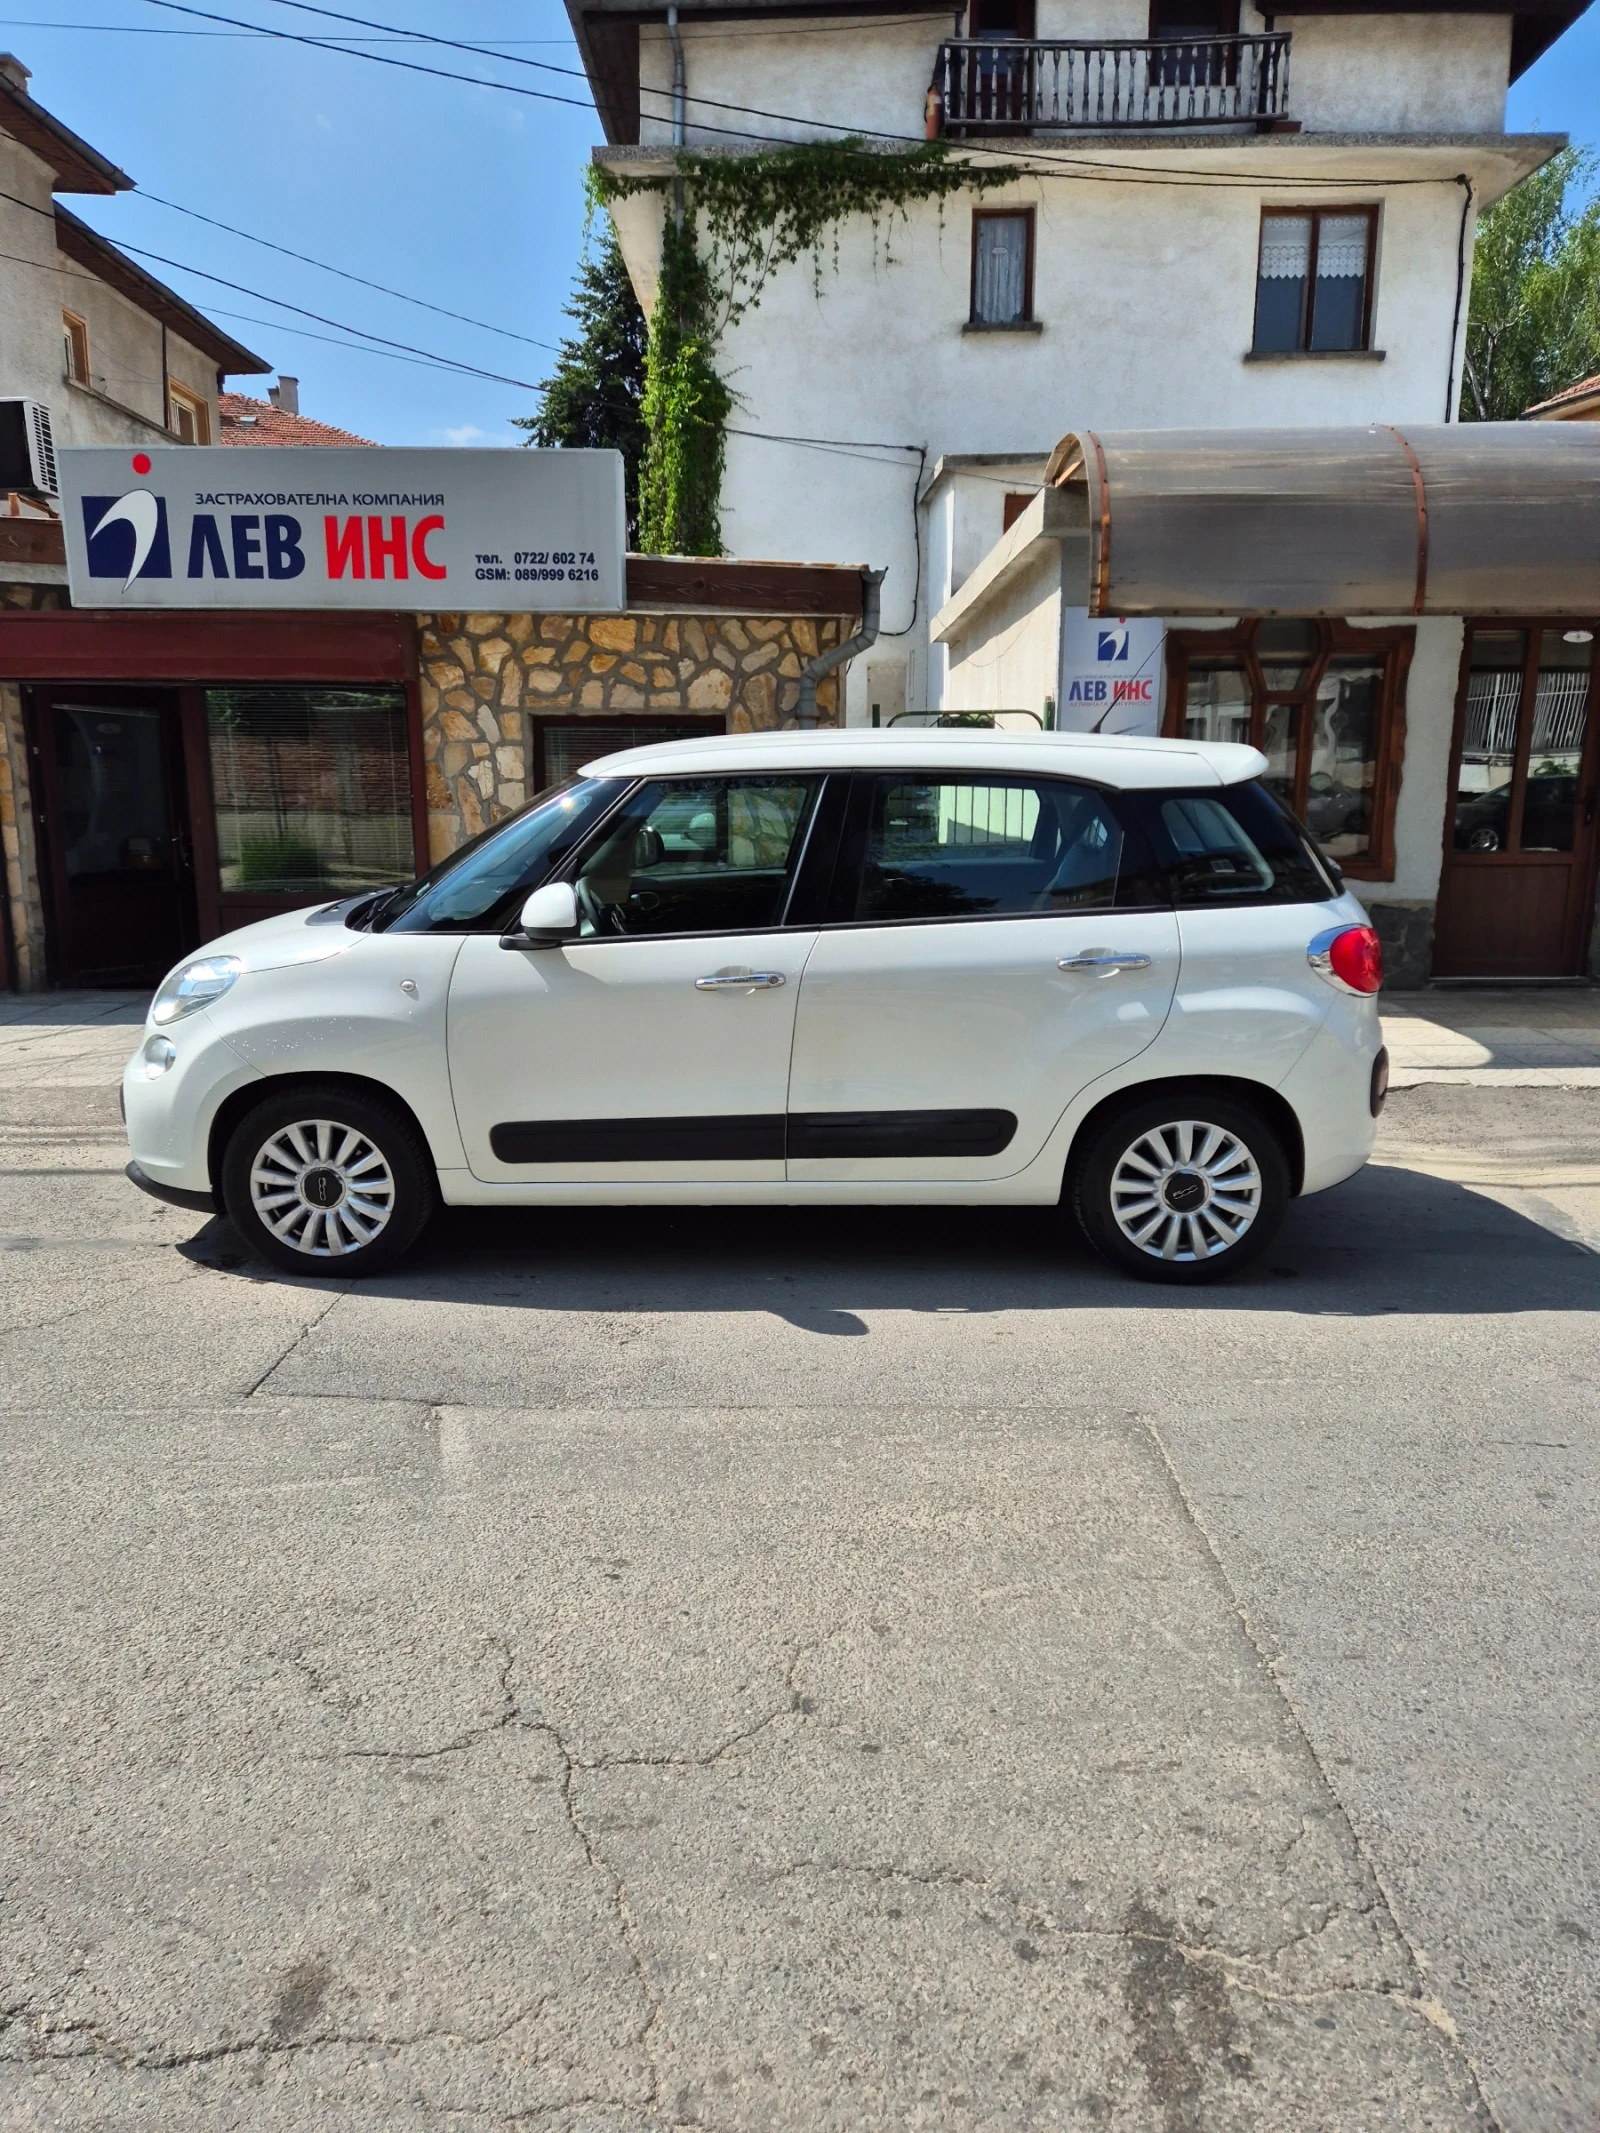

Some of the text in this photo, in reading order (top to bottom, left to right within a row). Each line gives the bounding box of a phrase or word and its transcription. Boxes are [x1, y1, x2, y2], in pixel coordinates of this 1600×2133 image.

[195, 493, 445, 505] ЗАСТРАХОВАТЕЛНА КОМПАНИЯ
[187, 514, 447, 580] ЛЕВ ИНС
[475, 552, 595, 564] тел. 0722/ 602 74
[475, 568, 599, 581] GSM: 089/999 6216
[1068, 680, 1153, 701] ЛЕВ ИНС
